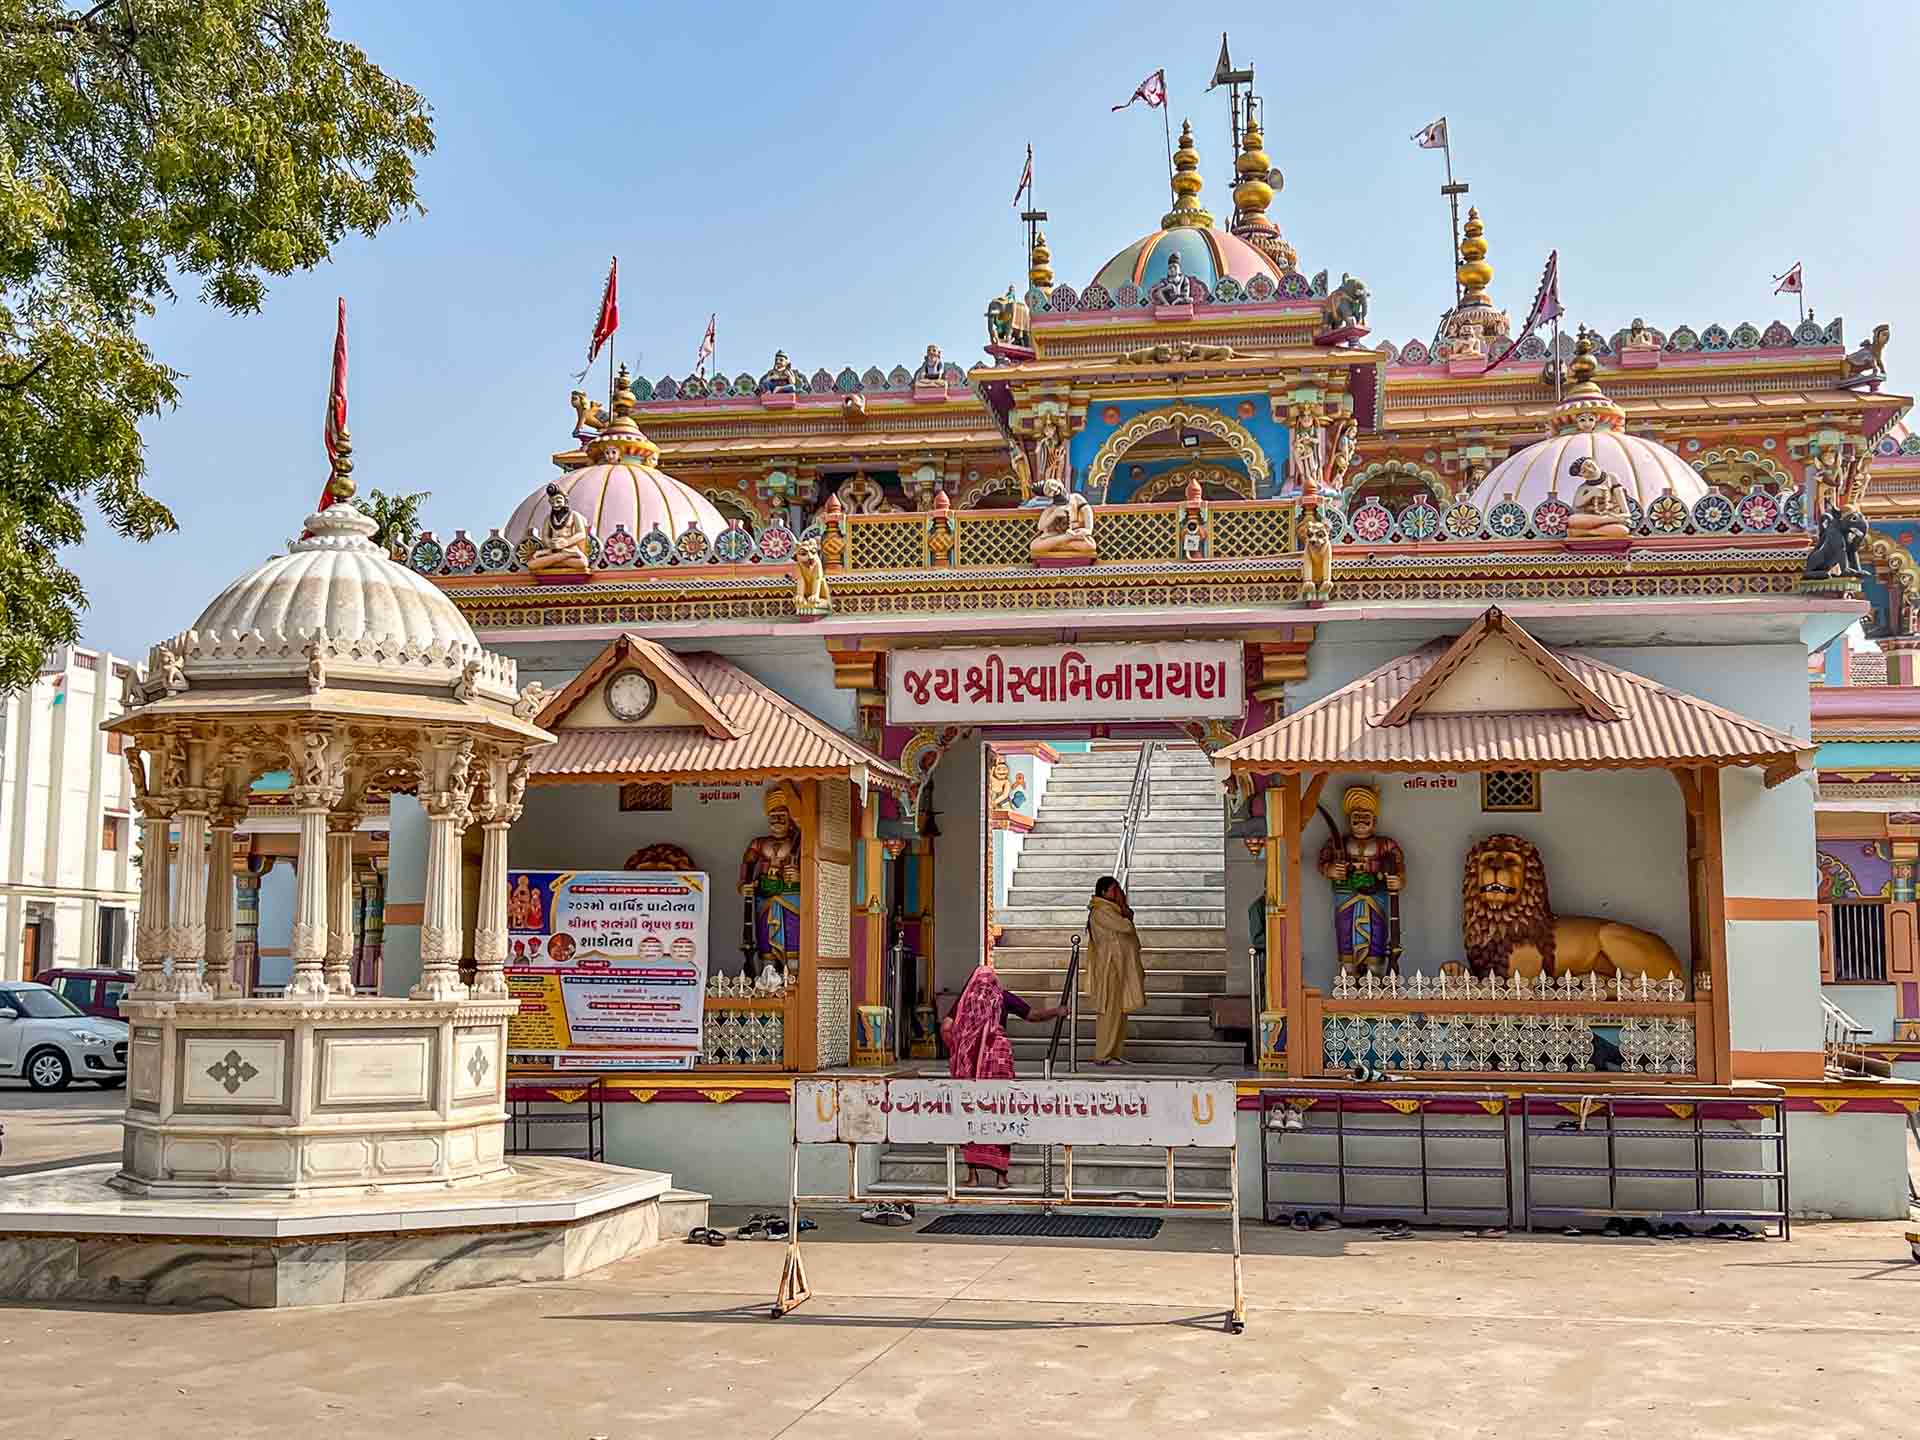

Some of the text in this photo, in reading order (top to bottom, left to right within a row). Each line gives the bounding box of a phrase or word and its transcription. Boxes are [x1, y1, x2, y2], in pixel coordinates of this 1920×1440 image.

[903, 650, 1226, 705] જય શ્રી સ્વામિનારાયણ
